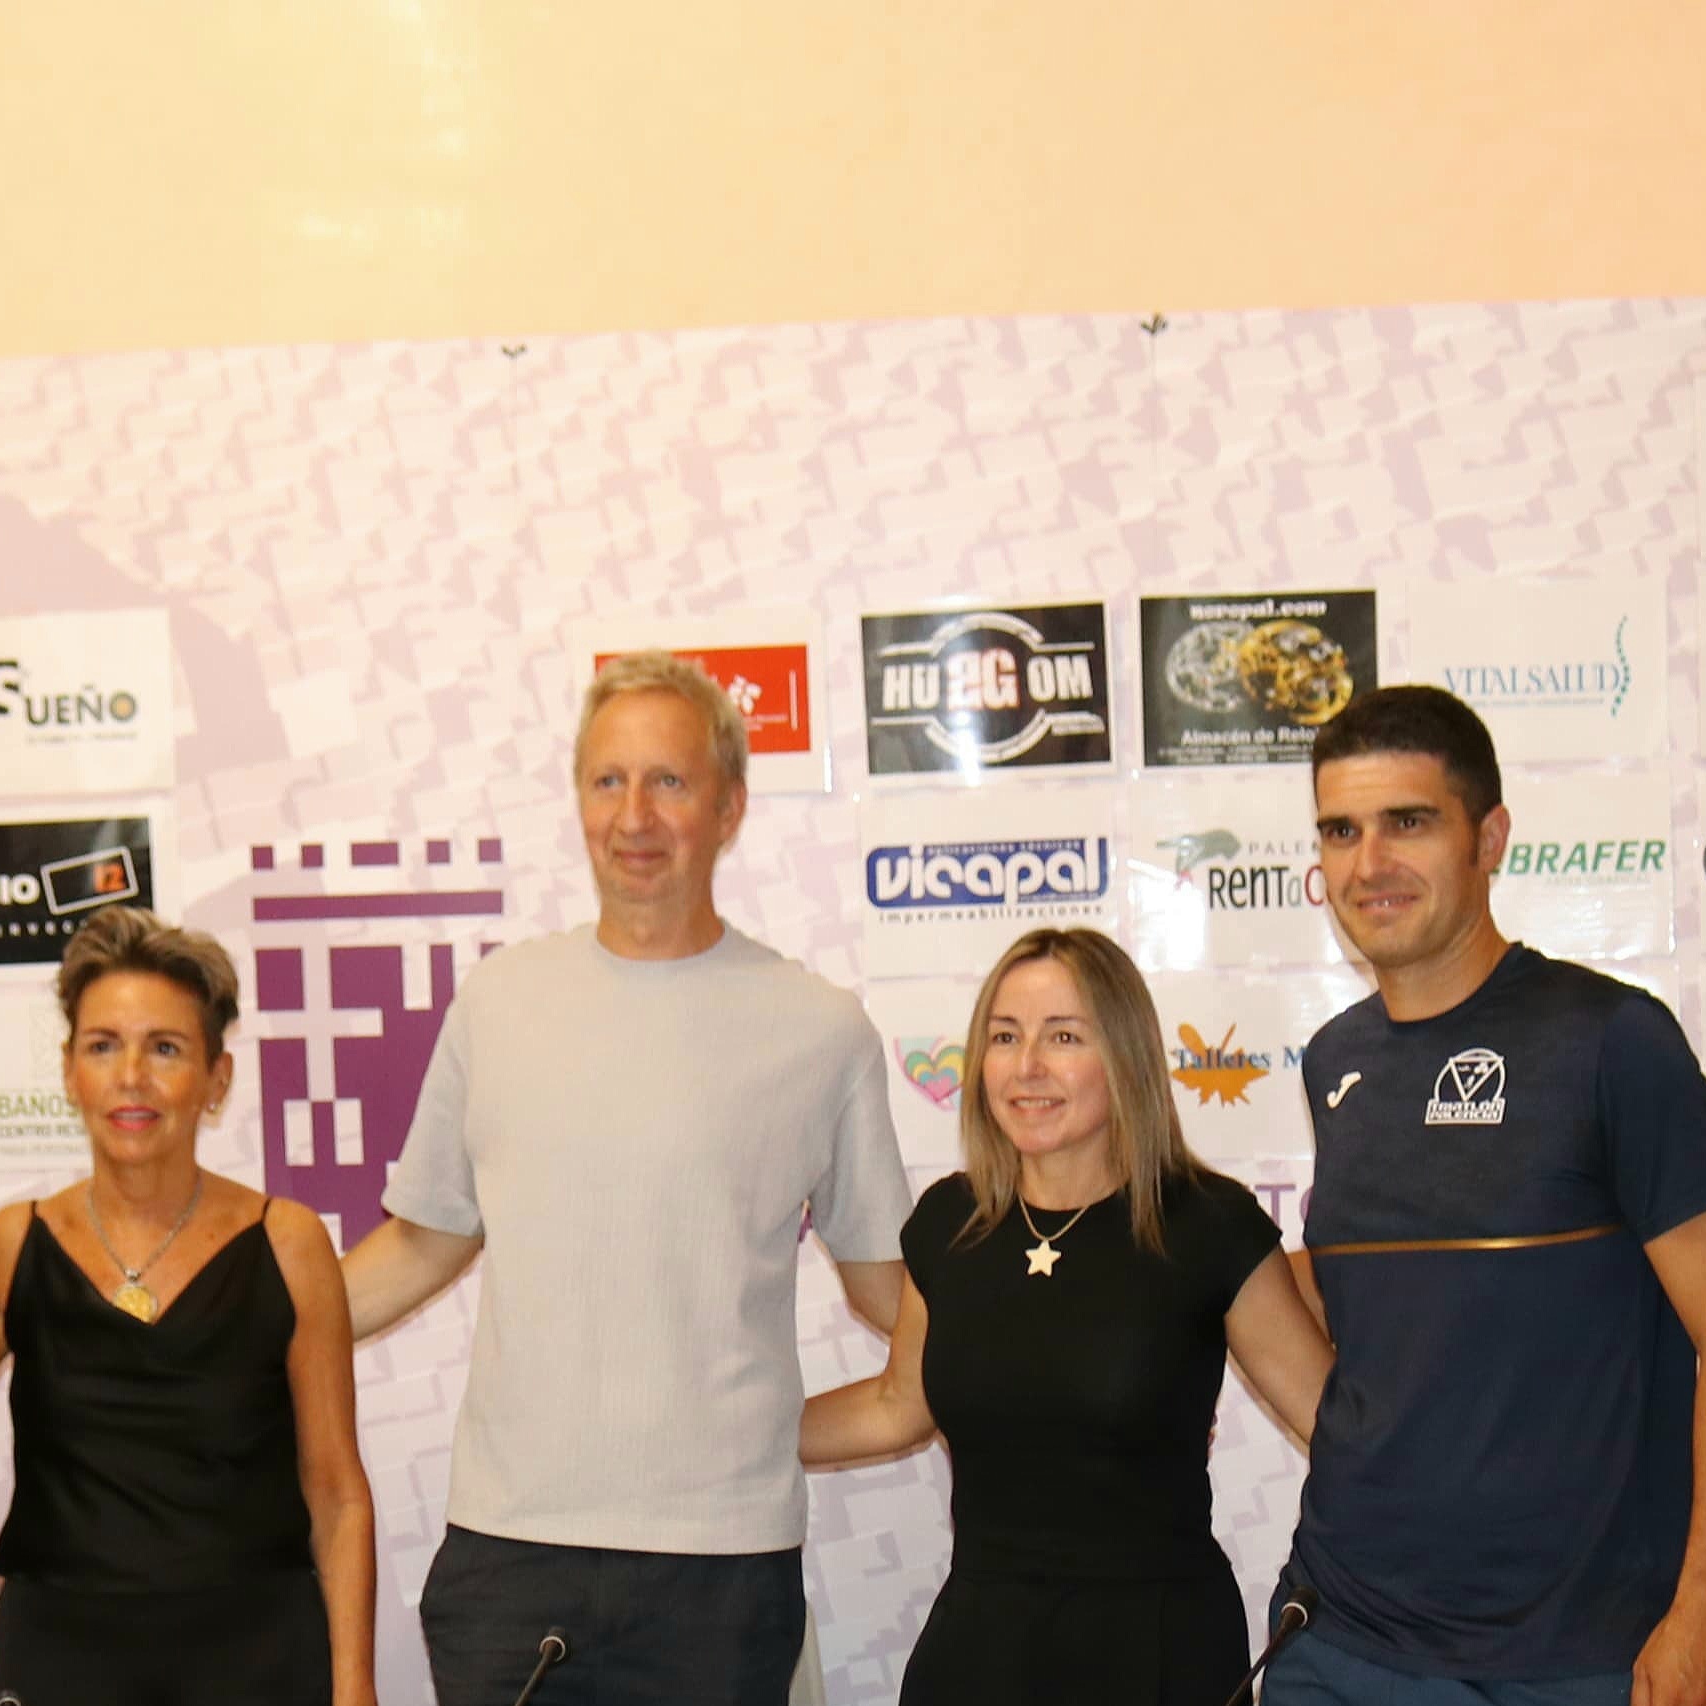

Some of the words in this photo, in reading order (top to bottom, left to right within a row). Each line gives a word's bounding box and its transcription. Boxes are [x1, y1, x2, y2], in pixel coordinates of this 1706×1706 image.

[876, 838, 1101, 904] vicapal
[1508, 840, 1665, 875] BRAFER
[879, 906, 1102, 923] impermeabilizaciones
[1176, 1049, 1271, 1070] Talleres
